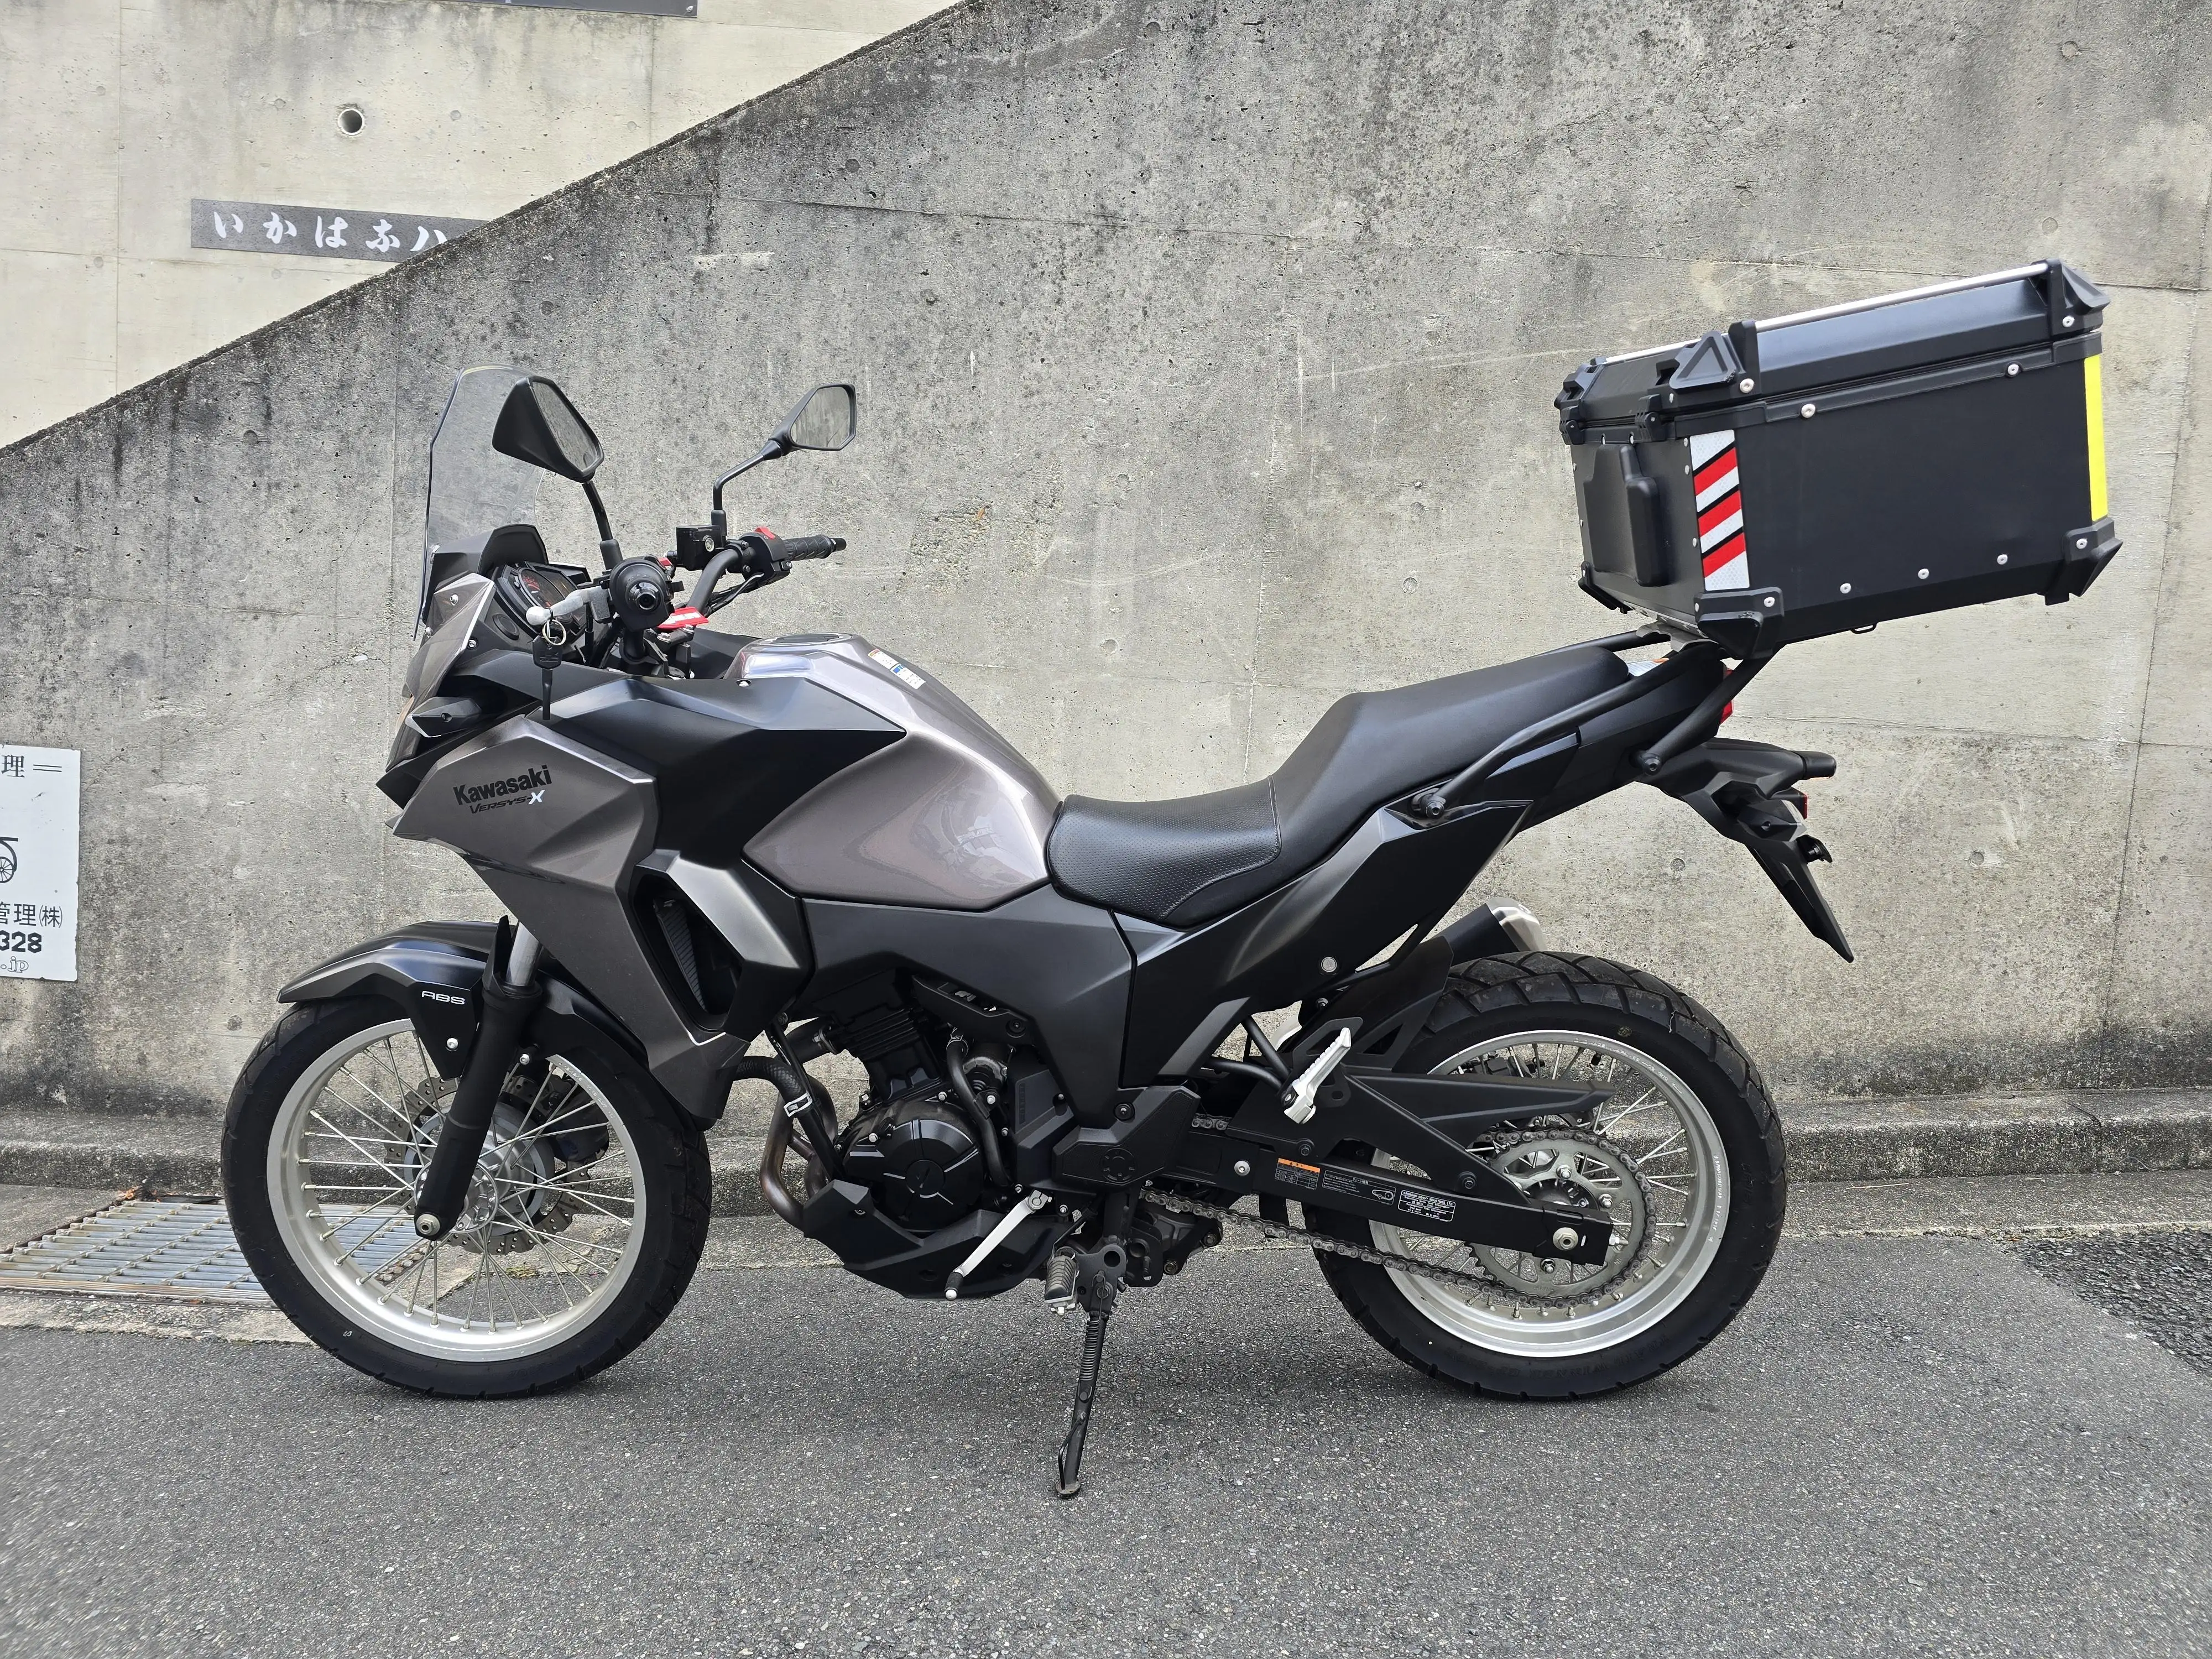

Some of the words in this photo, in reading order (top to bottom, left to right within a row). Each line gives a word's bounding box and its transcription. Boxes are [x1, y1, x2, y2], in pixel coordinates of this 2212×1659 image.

[453, 765, 552, 806] Kawasaki
[469, 789, 546, 814] VERSYS-X
[0, 930, 42, 953] 328
[421, 990, 465, 1005] ABS
